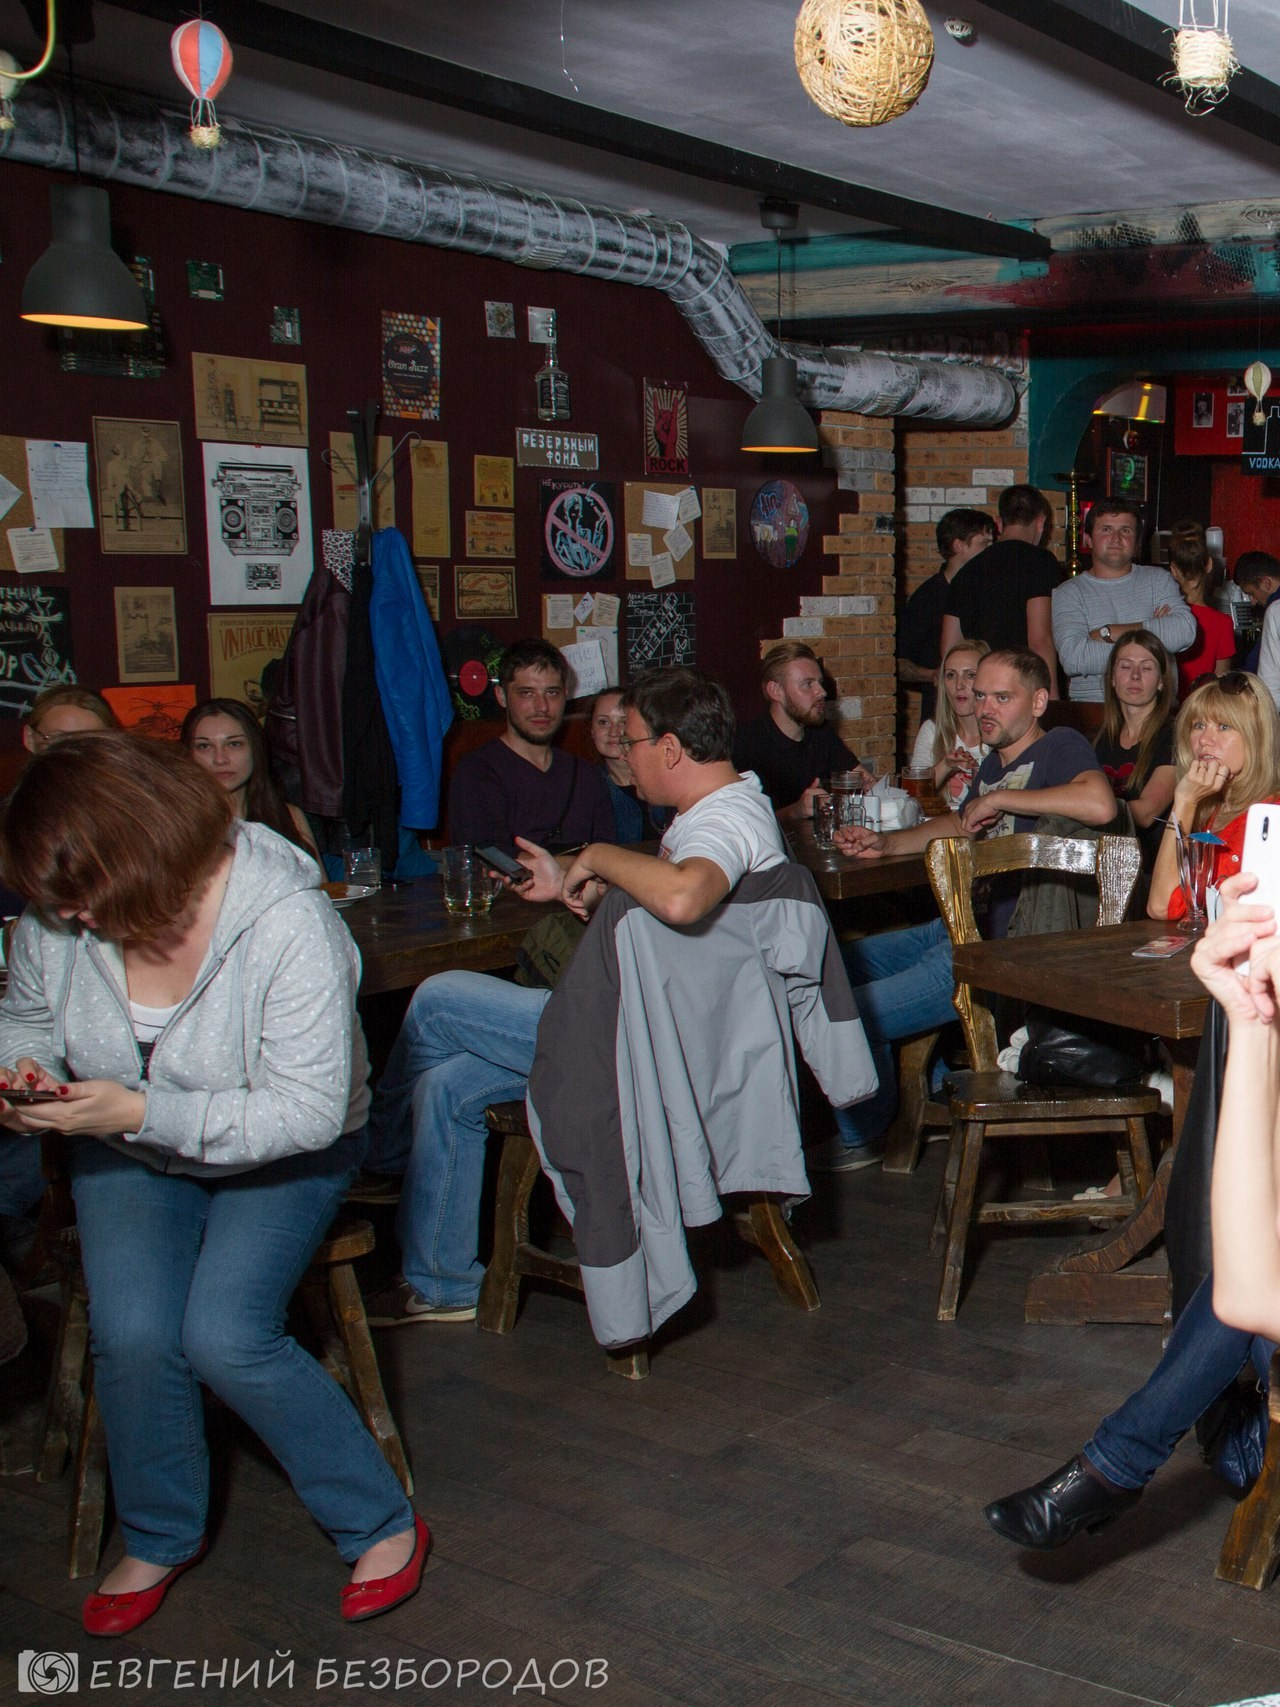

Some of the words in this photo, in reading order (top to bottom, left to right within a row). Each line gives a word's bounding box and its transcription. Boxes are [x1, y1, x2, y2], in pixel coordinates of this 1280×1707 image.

[522, 433, 595, 452] РЕЗЕРВНЫЙ
[546, 452, 580, 467] ФОНД
[650, 458, 686, 472] ROCK
[1249, 457, 1280, 469] VODKA
[219, 626, 265, 662] VINTAGE
